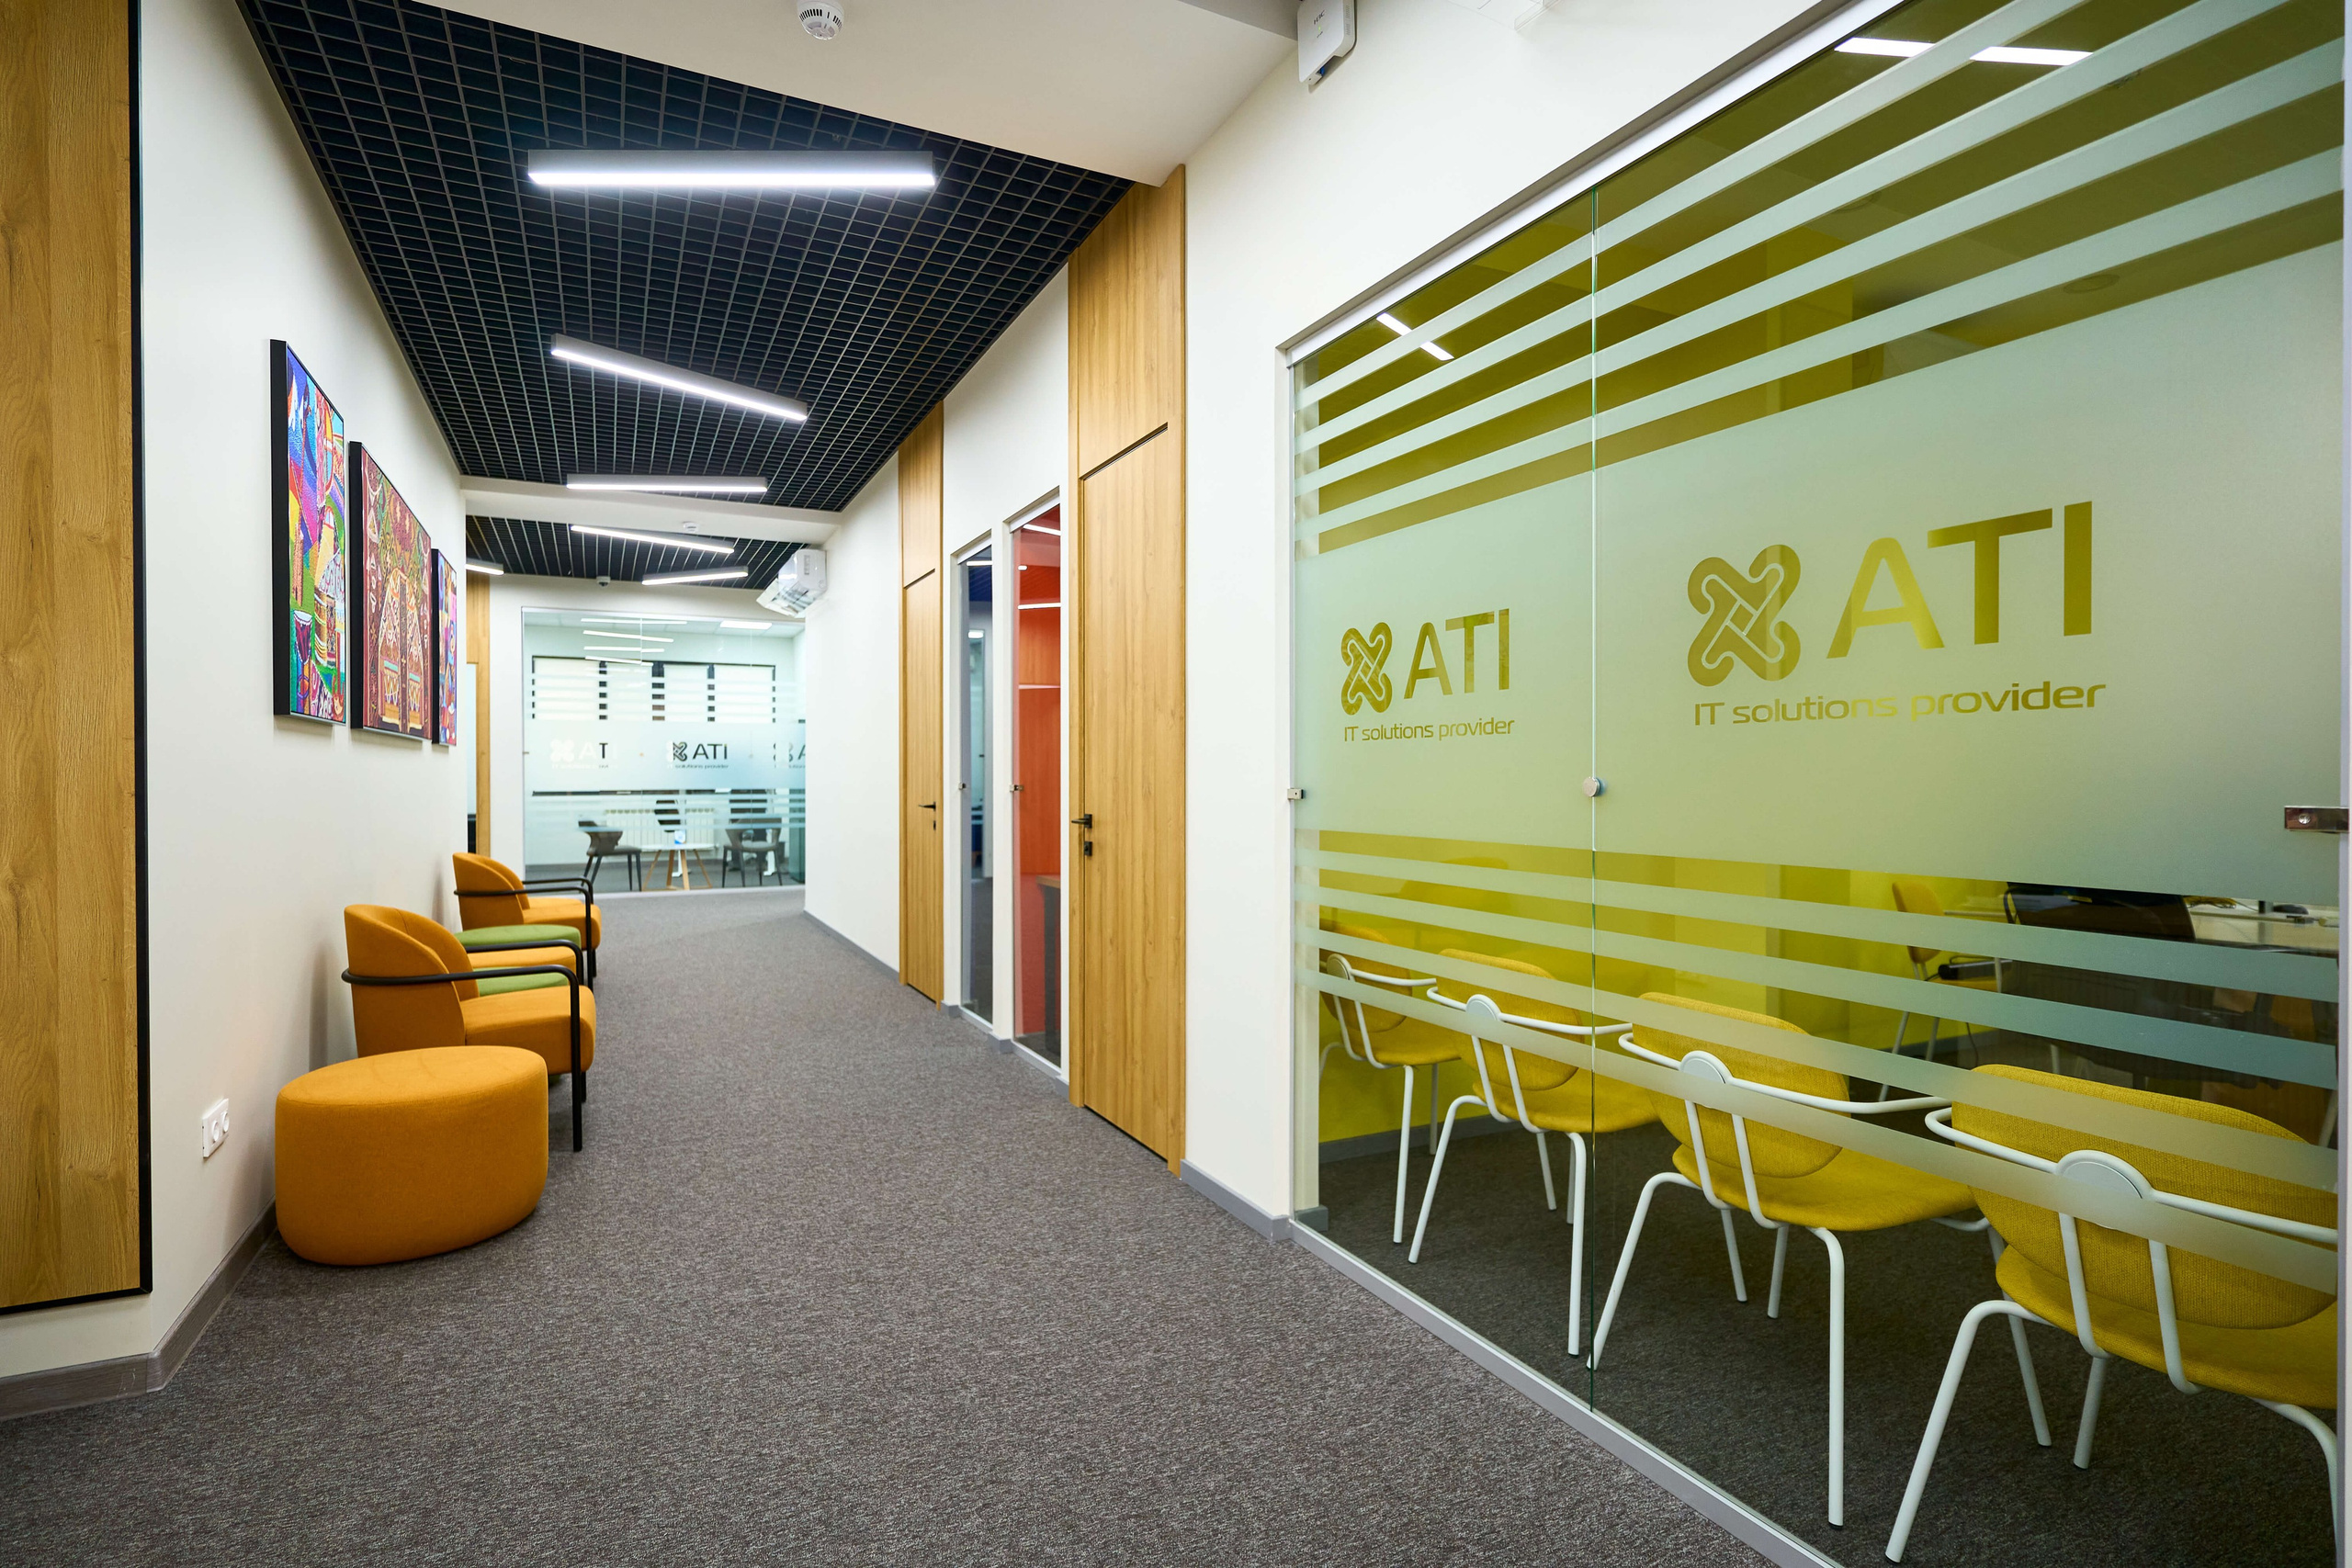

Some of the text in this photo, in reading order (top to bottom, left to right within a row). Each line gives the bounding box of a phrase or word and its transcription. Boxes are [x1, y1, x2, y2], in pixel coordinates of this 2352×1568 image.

[1826, 501, 2093, 659] ATI
[1403, 608, 1510, 699] ATI
[1694, 681, 2107, 726] IT solutions provider
[1344, 716, 1515, 741] IT solutions provider
[692, 743, 728, 760] ATI
